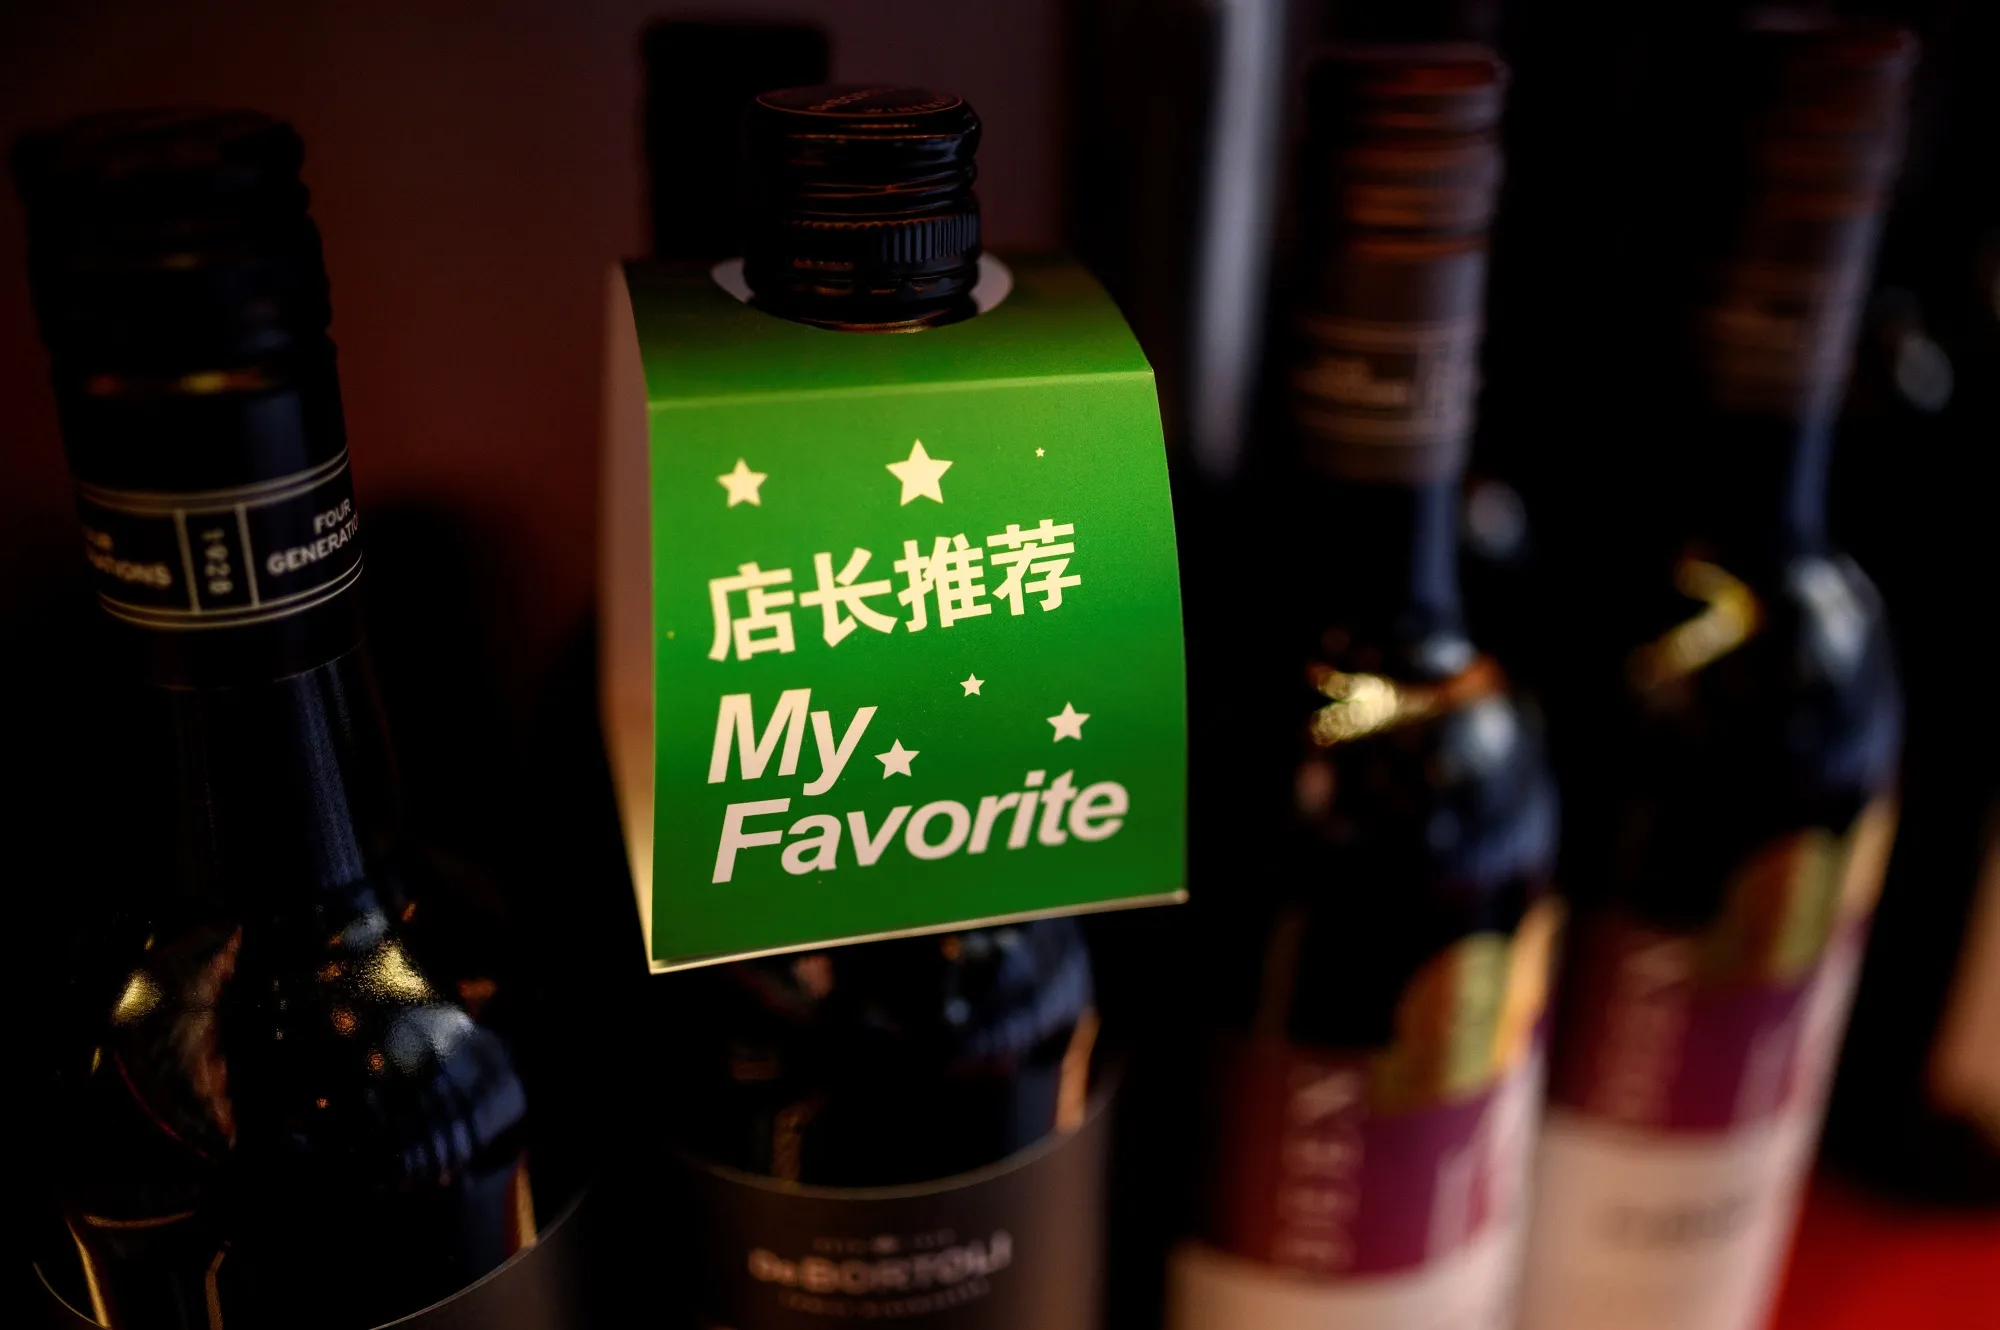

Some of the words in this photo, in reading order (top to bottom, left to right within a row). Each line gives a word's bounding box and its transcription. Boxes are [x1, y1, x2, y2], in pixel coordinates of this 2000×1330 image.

[313, 497, 351, 535] FOUR
[707, 518, 1081, 662] 店长推荐
[707, 688, 878, 796] My
[711, 769, 1130, 884] Favorite
